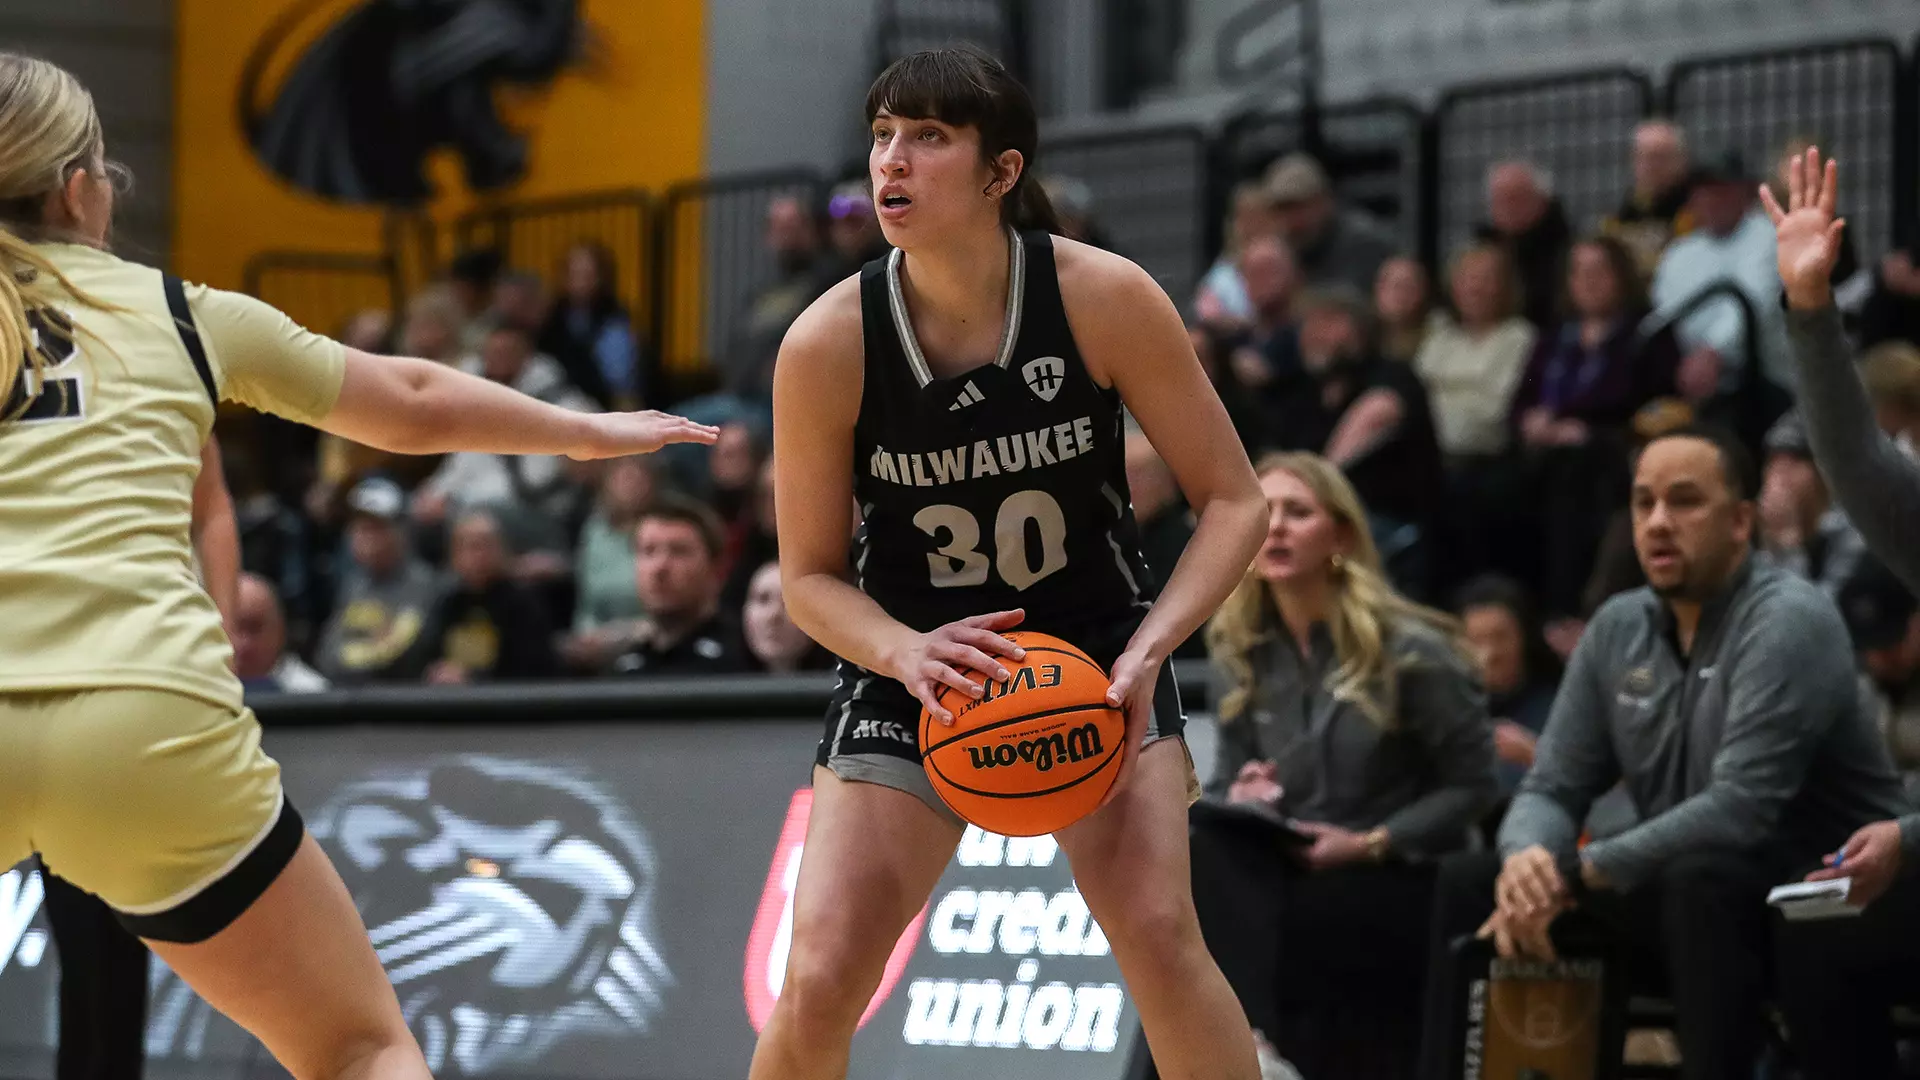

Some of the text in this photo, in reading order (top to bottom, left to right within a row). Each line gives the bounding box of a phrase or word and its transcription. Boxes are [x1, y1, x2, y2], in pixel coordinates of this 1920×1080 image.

[870, 416, 1094, 487] MILWAUKEE
[913, 489, 1068, 592] 30
[967, 722, 1104, 772] Wilson
[998, 721, 1068, 741] INDOOR GAME BALL
[903, 957, 1124, 1054] union
